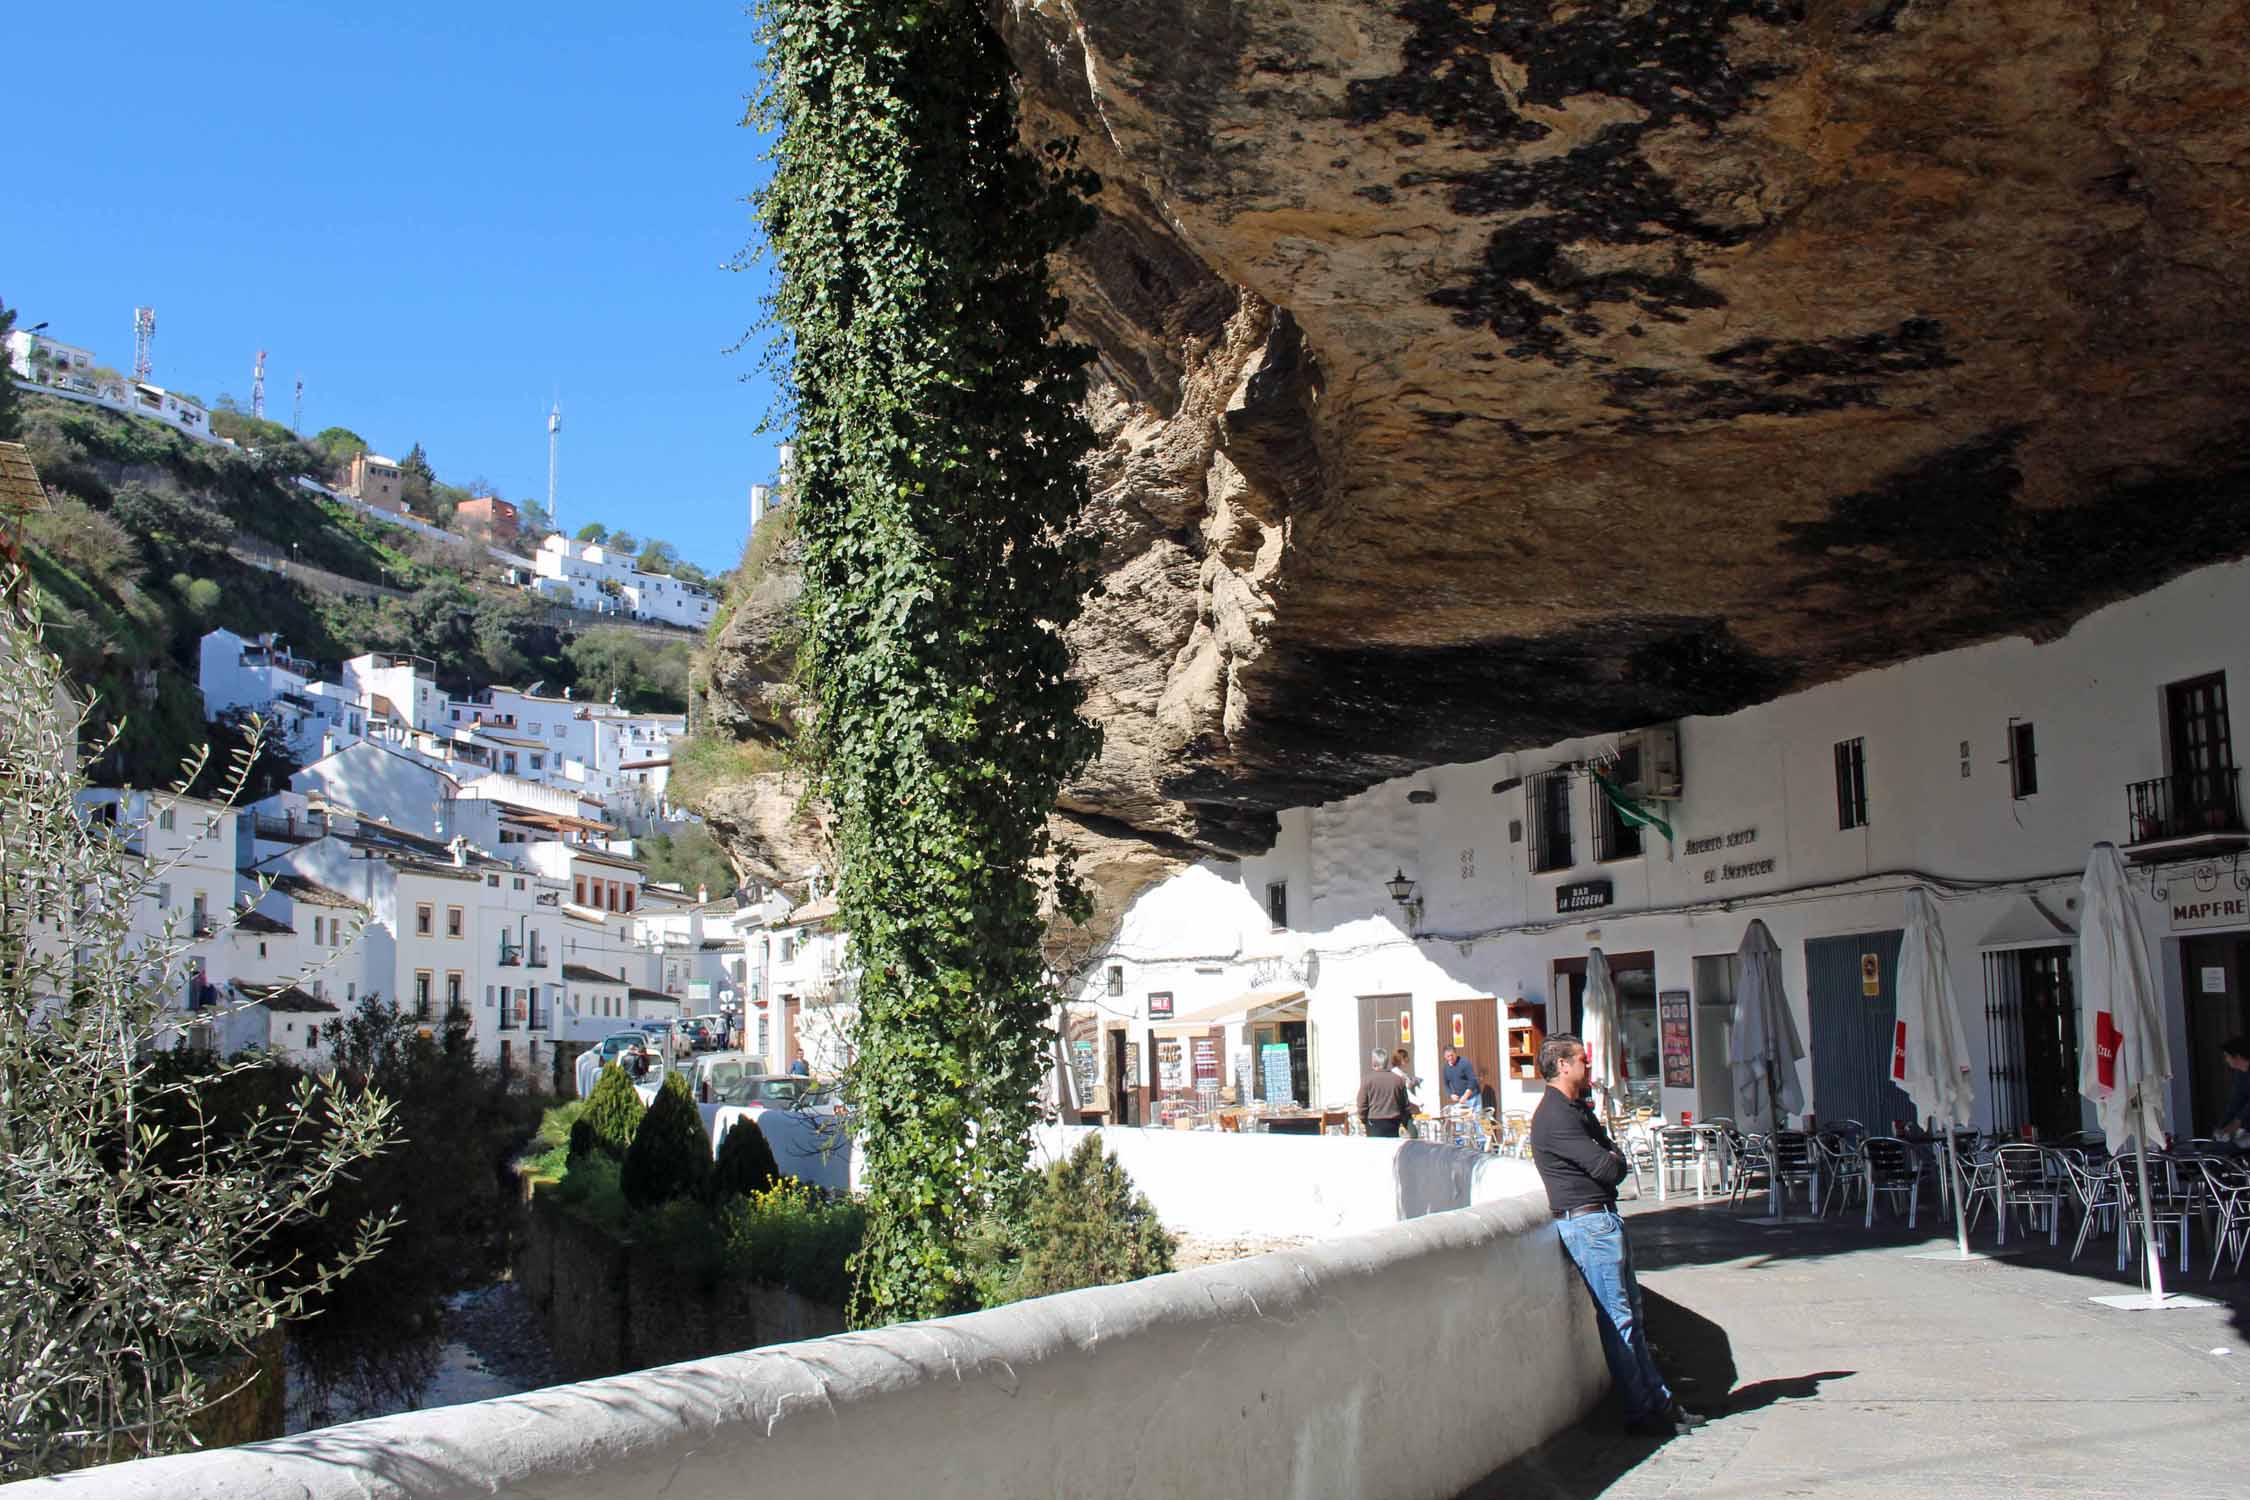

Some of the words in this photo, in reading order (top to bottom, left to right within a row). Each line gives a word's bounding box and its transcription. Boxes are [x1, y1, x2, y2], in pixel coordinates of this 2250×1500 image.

[1572, 887, 1589, 897] BAR
[1560, 898, 1568, 909] LA
[2174, 899, 2246, 921] MAPFRE
